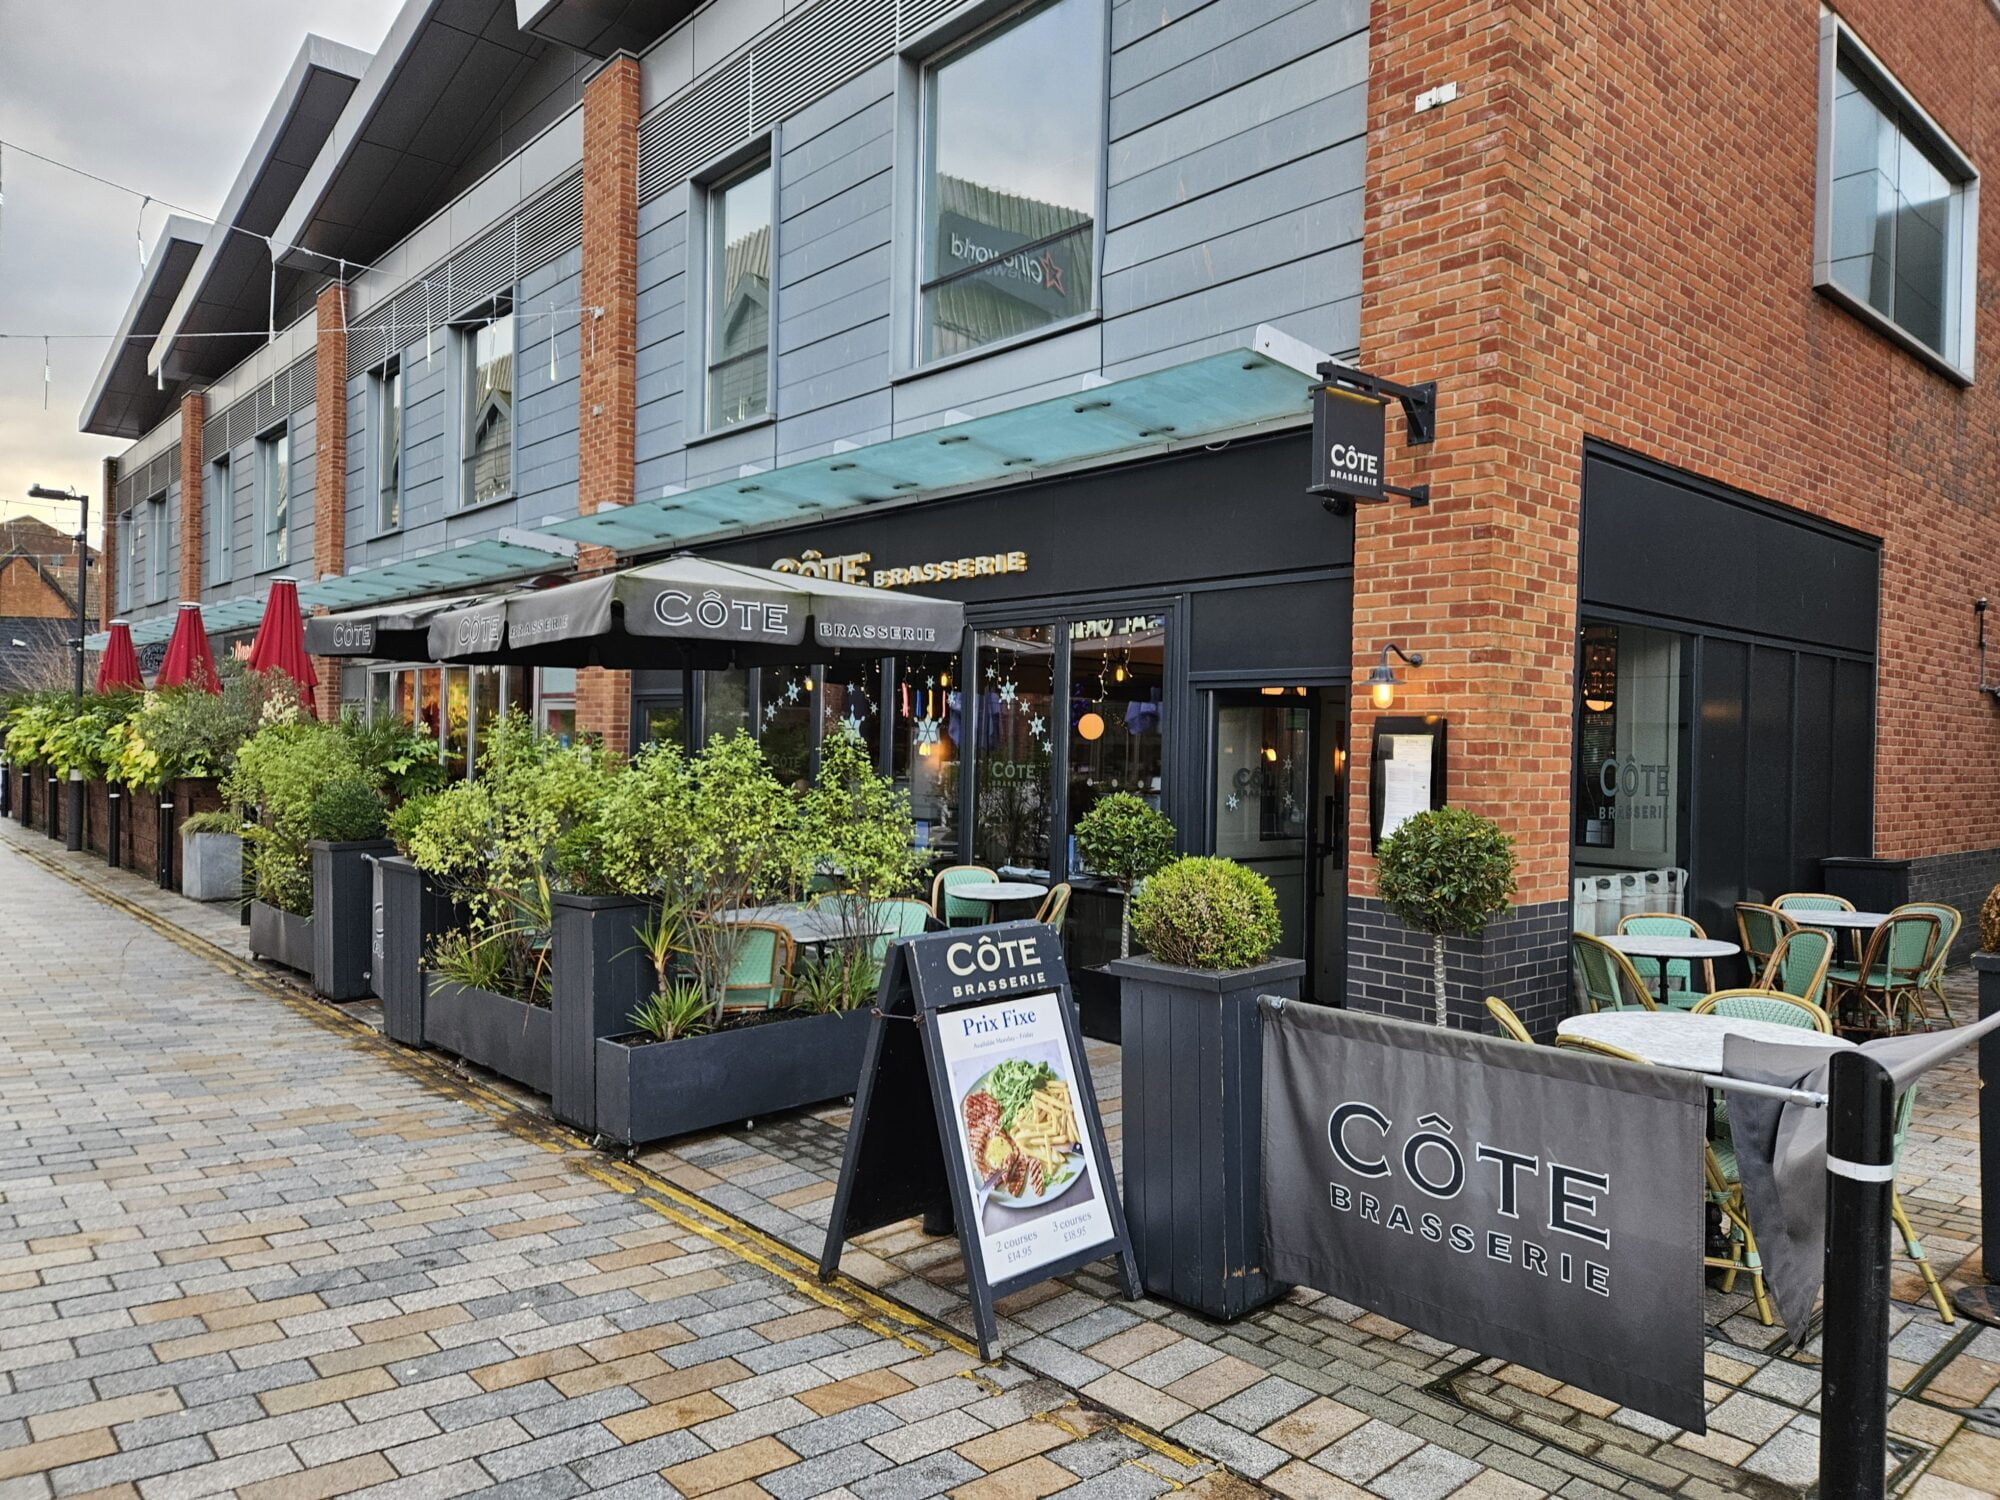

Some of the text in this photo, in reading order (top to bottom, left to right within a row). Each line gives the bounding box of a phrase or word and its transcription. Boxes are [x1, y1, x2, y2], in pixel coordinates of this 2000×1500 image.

[1331, 444, 1378, 475] CÔTE
[1330, 469, 1377, 487] BRASSERIE
[873, 551, 1029, 588] BRASSERIE
[458, 612, 569, 646] CÔTE BRASSERIE
[654, 590, 936, 643] CÔTE BRASSERIE
[333, 622, 372, 647] CÔTE
[992, 760, 1036, 779] CÔTE
[1600, 754, 1671, 798] CÔTE
[946, 935, 1041, 976] CÔTE
[952, 972, 1046, 997] BRASSERIE
[962, 1009, 1037, 1036] Prix Fixe
[1328, 1101, 1610, 1250] CÔTE
[1053, 1212, 1092, 1233] 3 courses
[1064, 1226, 1087, 1243] £18.95
[996, 1231, 1038, 1253] 2 courses
[1329, 1182, 1610, 1297] BRASSERIE
[1007, 1246, 1033, 1263] £14.95
